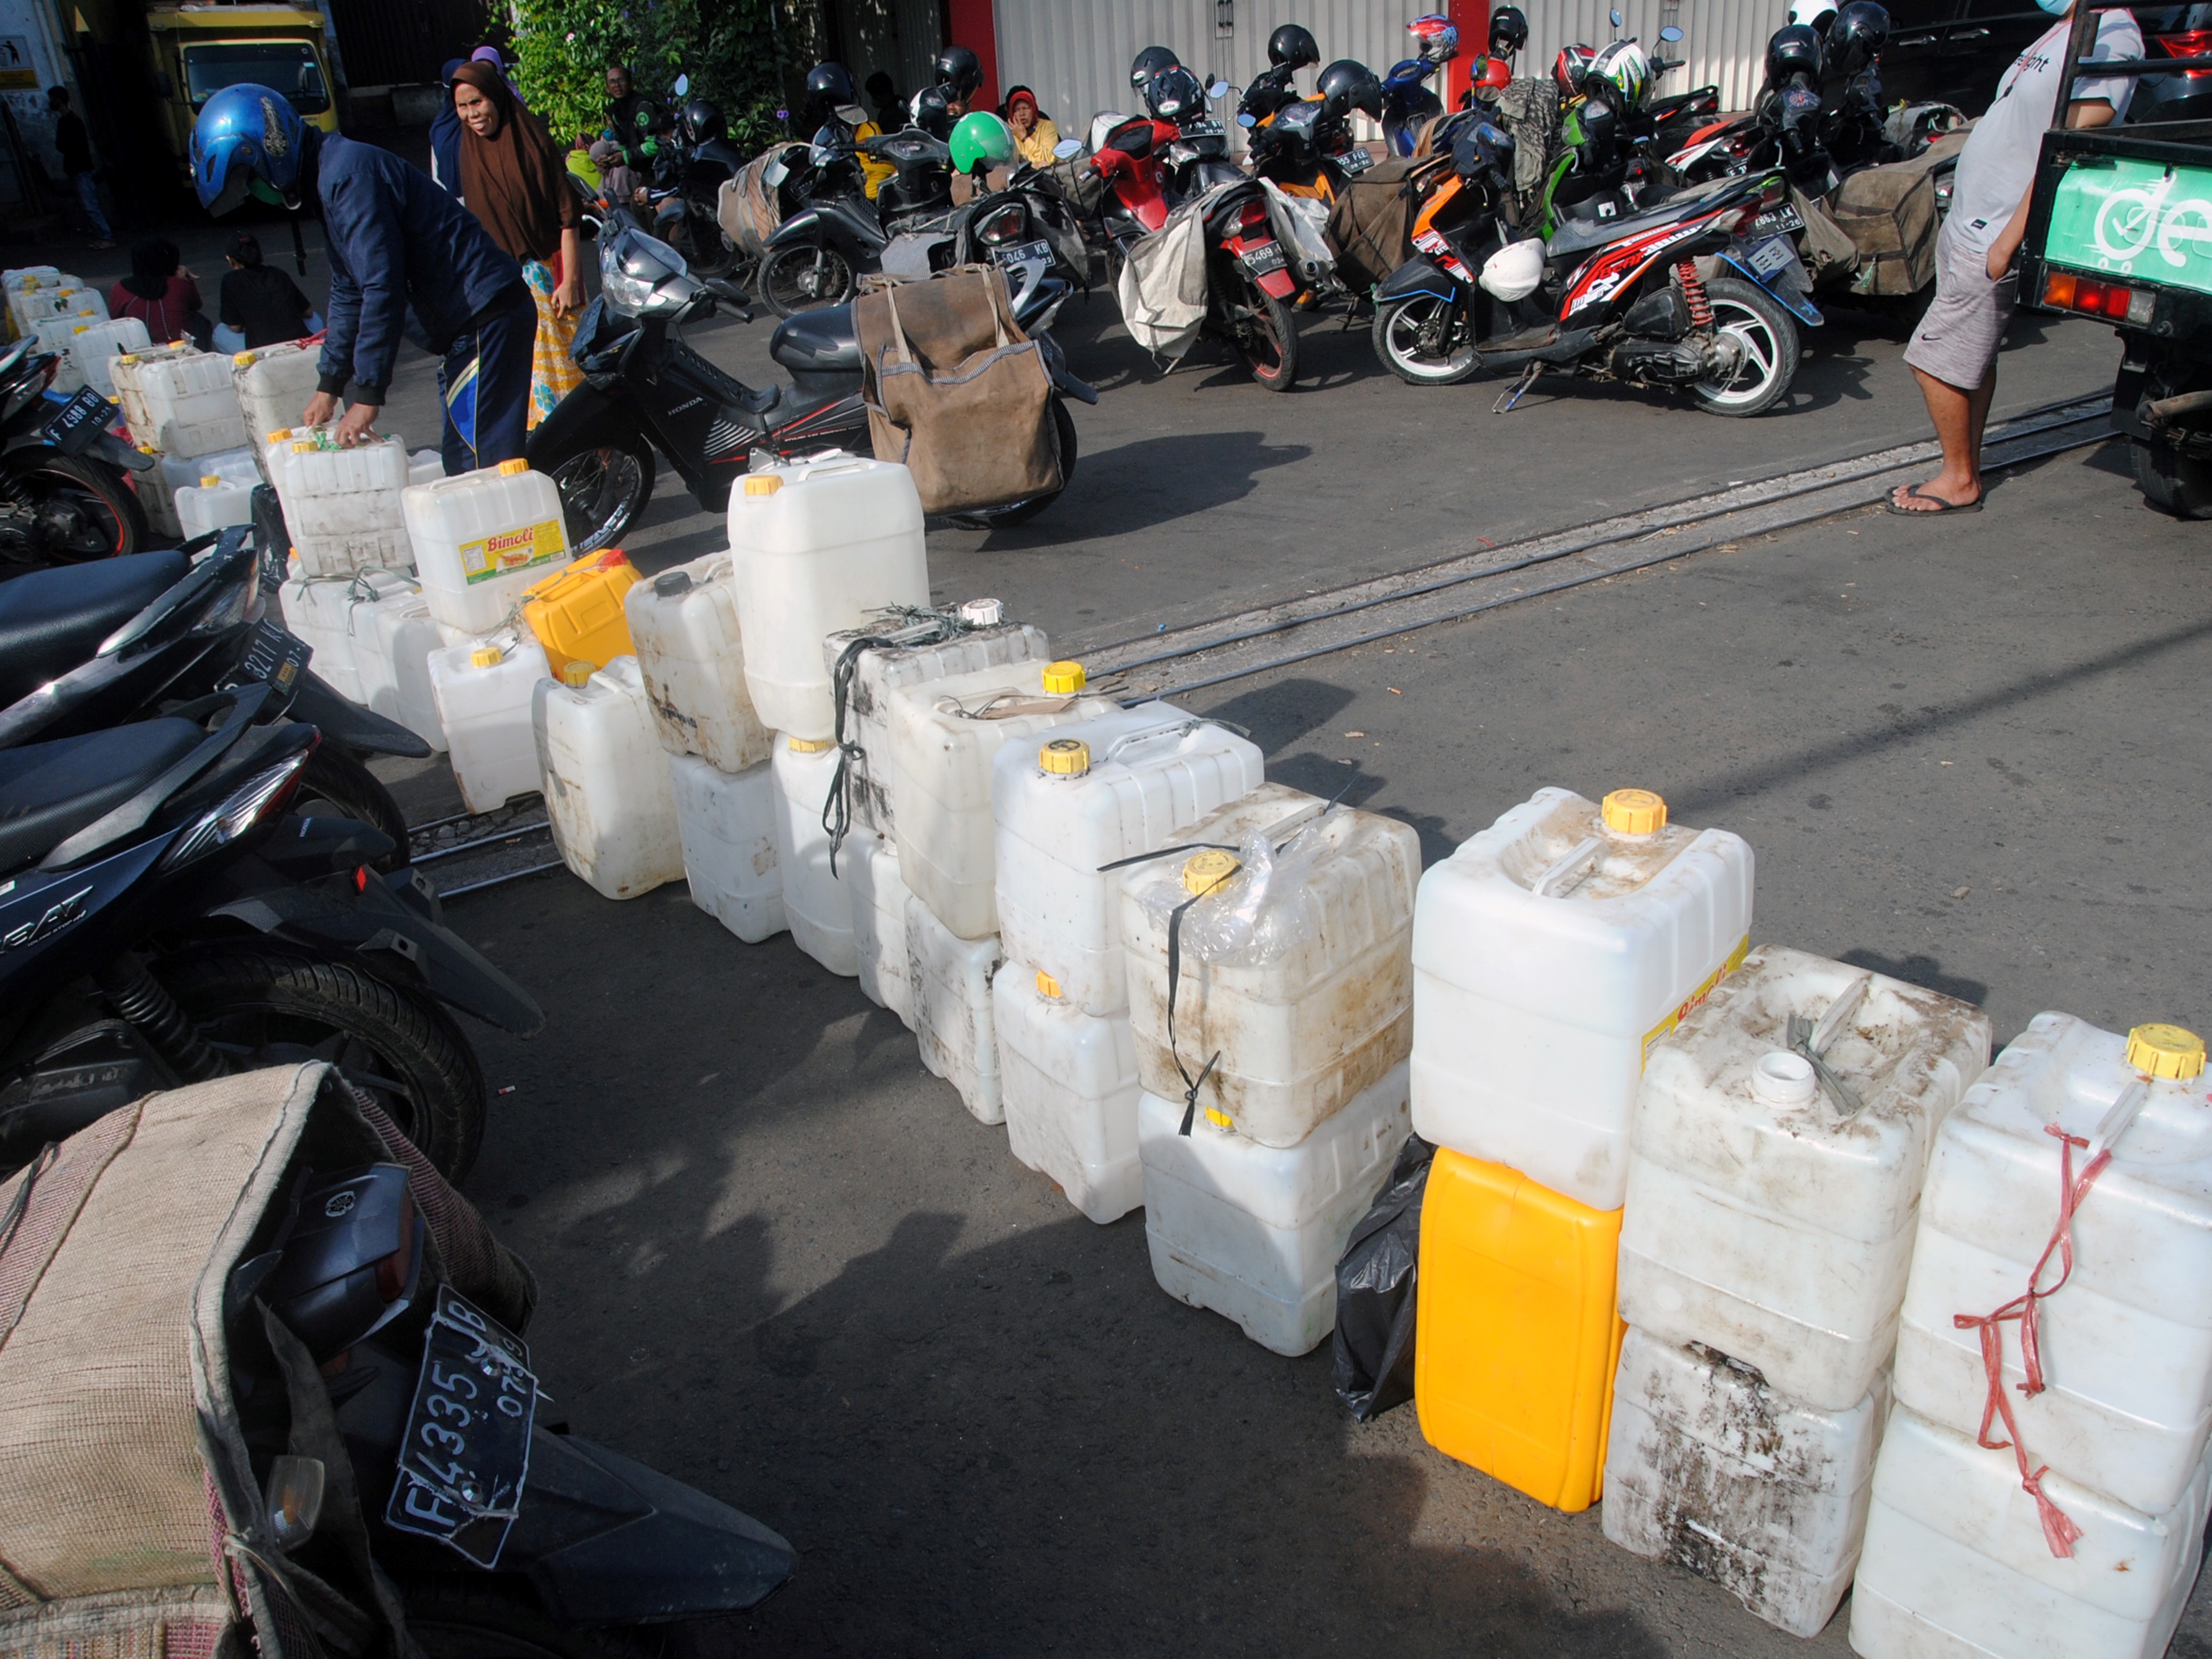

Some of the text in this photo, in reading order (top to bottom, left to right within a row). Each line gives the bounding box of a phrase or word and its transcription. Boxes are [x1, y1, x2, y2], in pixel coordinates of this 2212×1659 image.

[1779, 206, 1794, 219] LK
[1034, 242, 1049, 255] KB
[667, 396, 704, 416] HONDA
[49, 428, 62, 441] F
[62, 405, 88, 429] 4988
[487, 526, 534, 553] Bimoli
[244, 638, 277, 680] 3217
[416, 1363, 479, 1485] 4335
[405, 1487, 457, 1528] F
